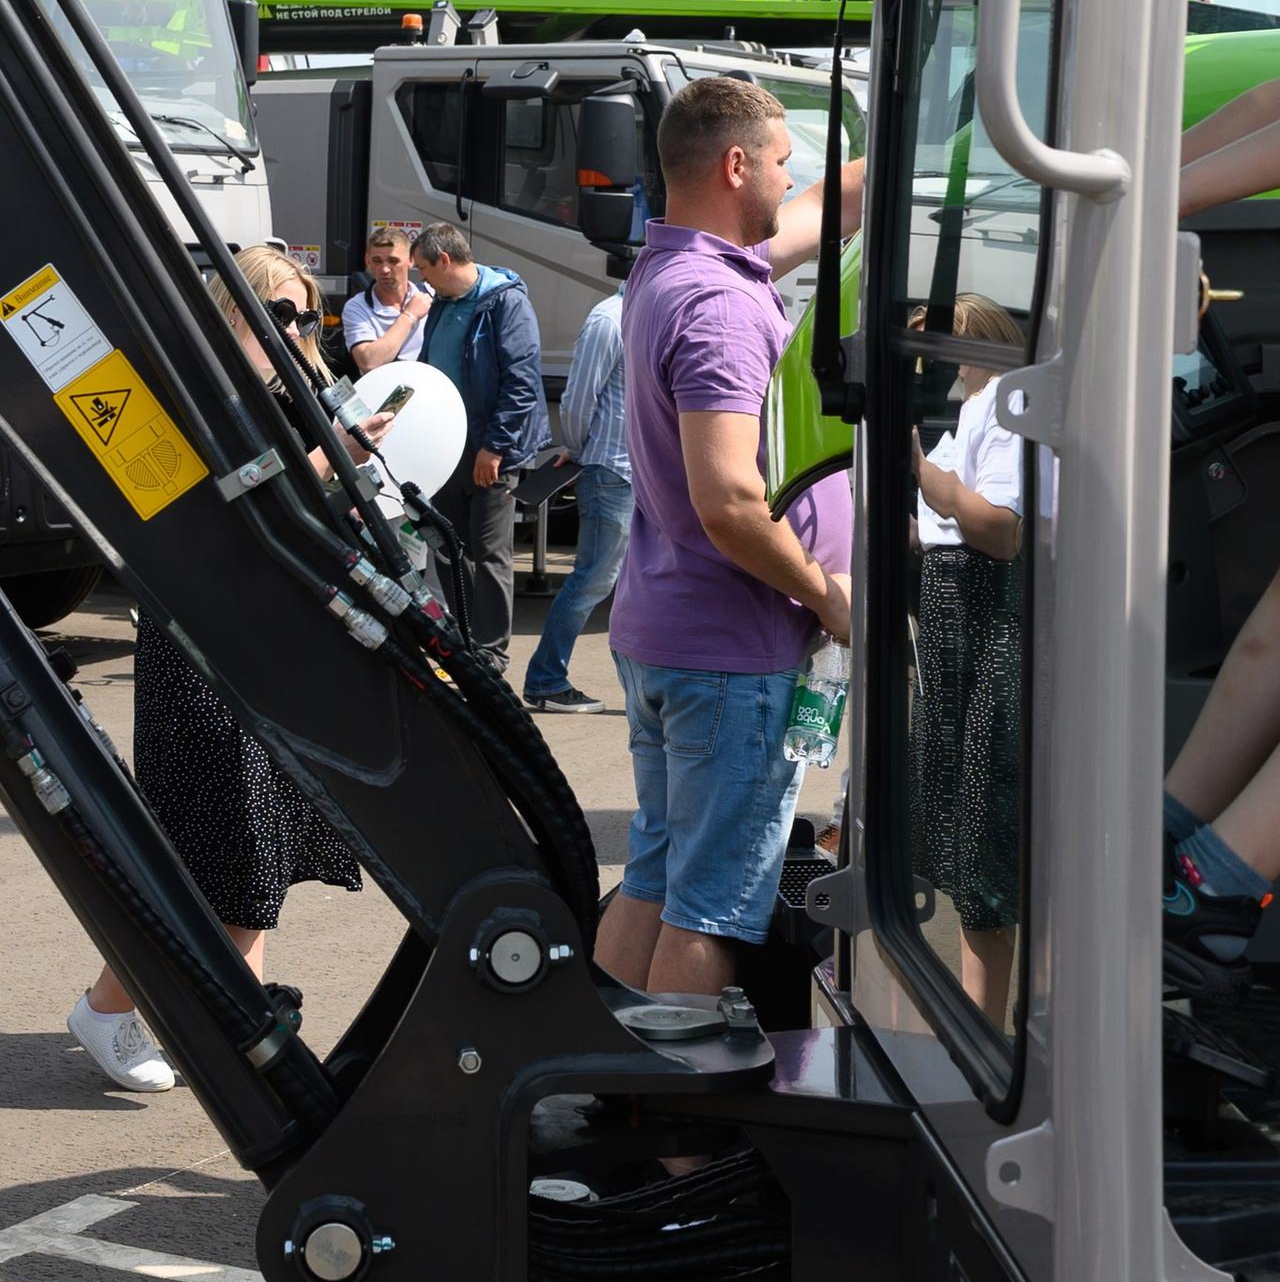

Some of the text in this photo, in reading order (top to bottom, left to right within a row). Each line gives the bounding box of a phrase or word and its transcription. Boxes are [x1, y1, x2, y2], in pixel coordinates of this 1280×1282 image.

[276, 11, 290, 20] НЕ
[292, 9, 319, 19] СТОЙ
[321, 9, 342, 18] ПОД
[14, 275, 53, 304] Внимание
[798, 705, 818, 715] bon
[797, 714, 824, 725] aqua
